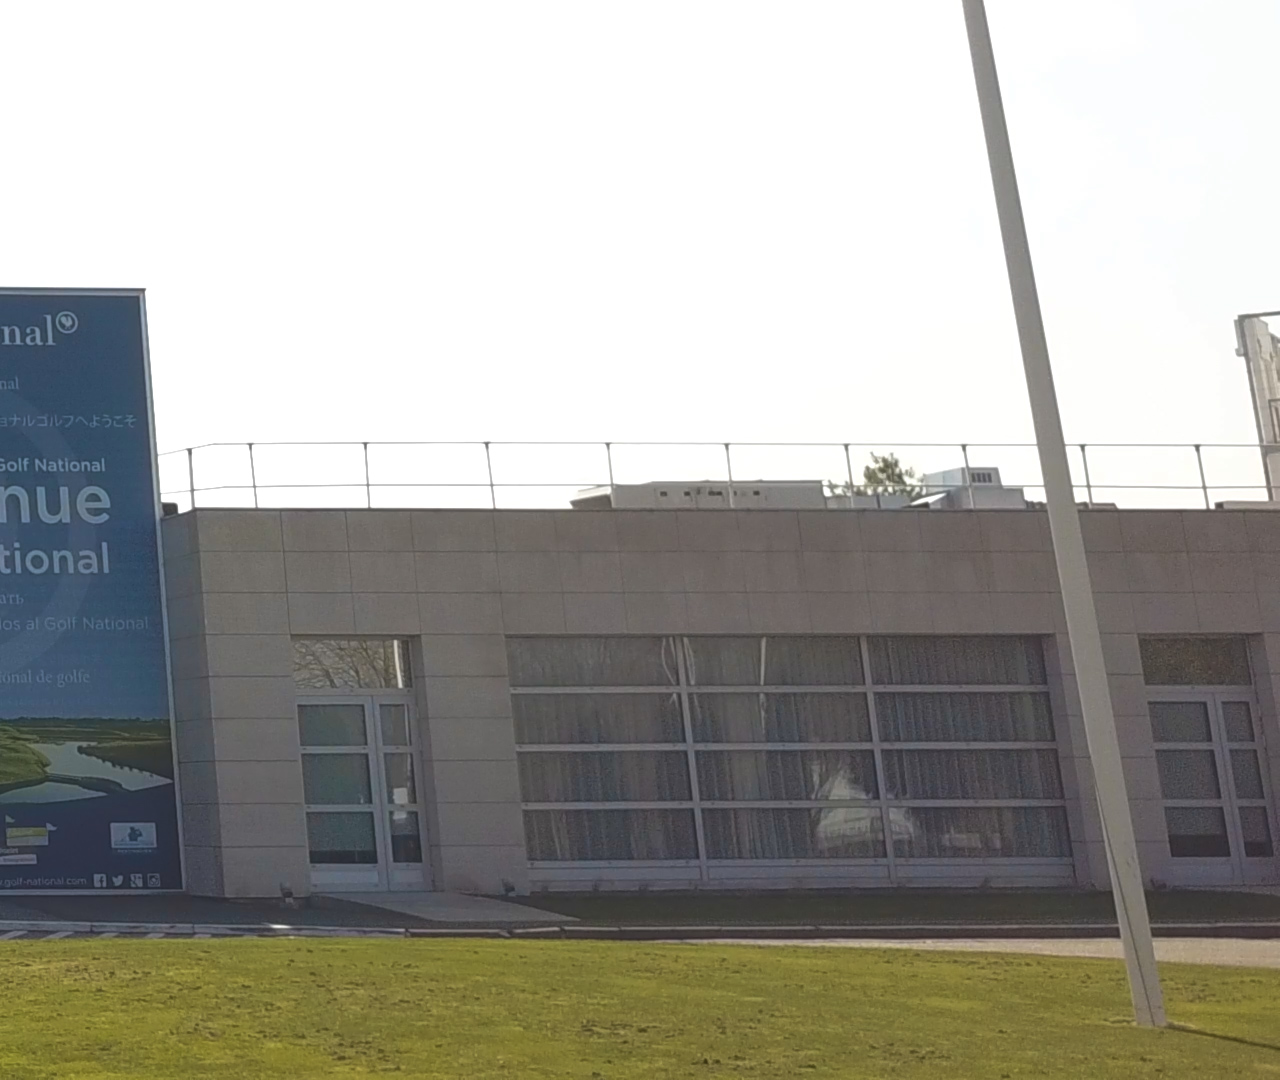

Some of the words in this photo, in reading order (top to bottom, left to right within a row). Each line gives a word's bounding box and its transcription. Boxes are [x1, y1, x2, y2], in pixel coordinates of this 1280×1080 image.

[35, 458, 105, 473] National
[25, 617, 39, 631] al
[44, 616, 77, 631] Golf
[83, 617, 148, 630] National
